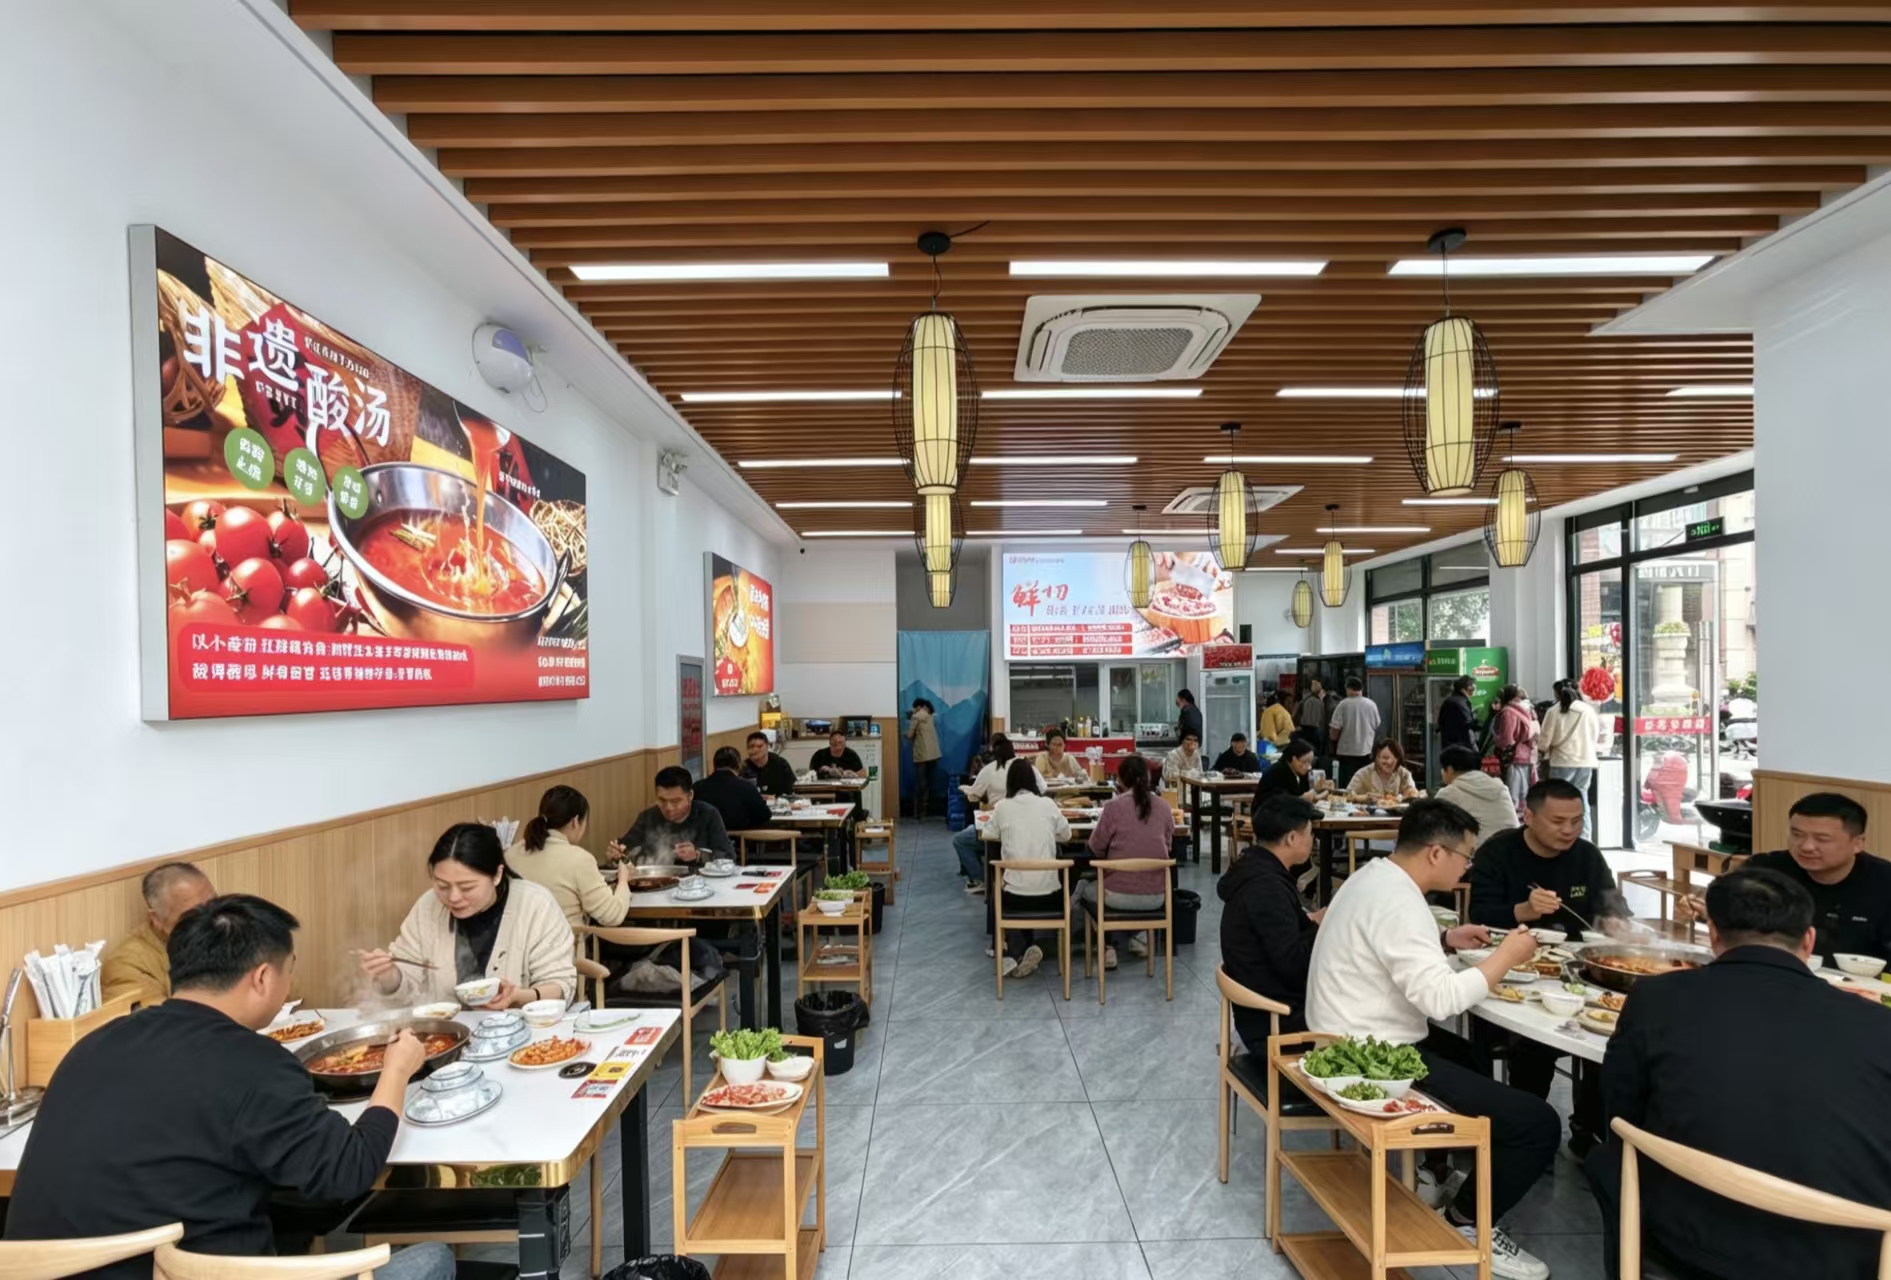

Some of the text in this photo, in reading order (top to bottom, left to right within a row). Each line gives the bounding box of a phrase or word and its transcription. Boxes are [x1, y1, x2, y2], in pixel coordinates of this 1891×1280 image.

[184, 302, 391, 447] 非遗酸汤
[1011, 580, 1069, 617] 鲜切
